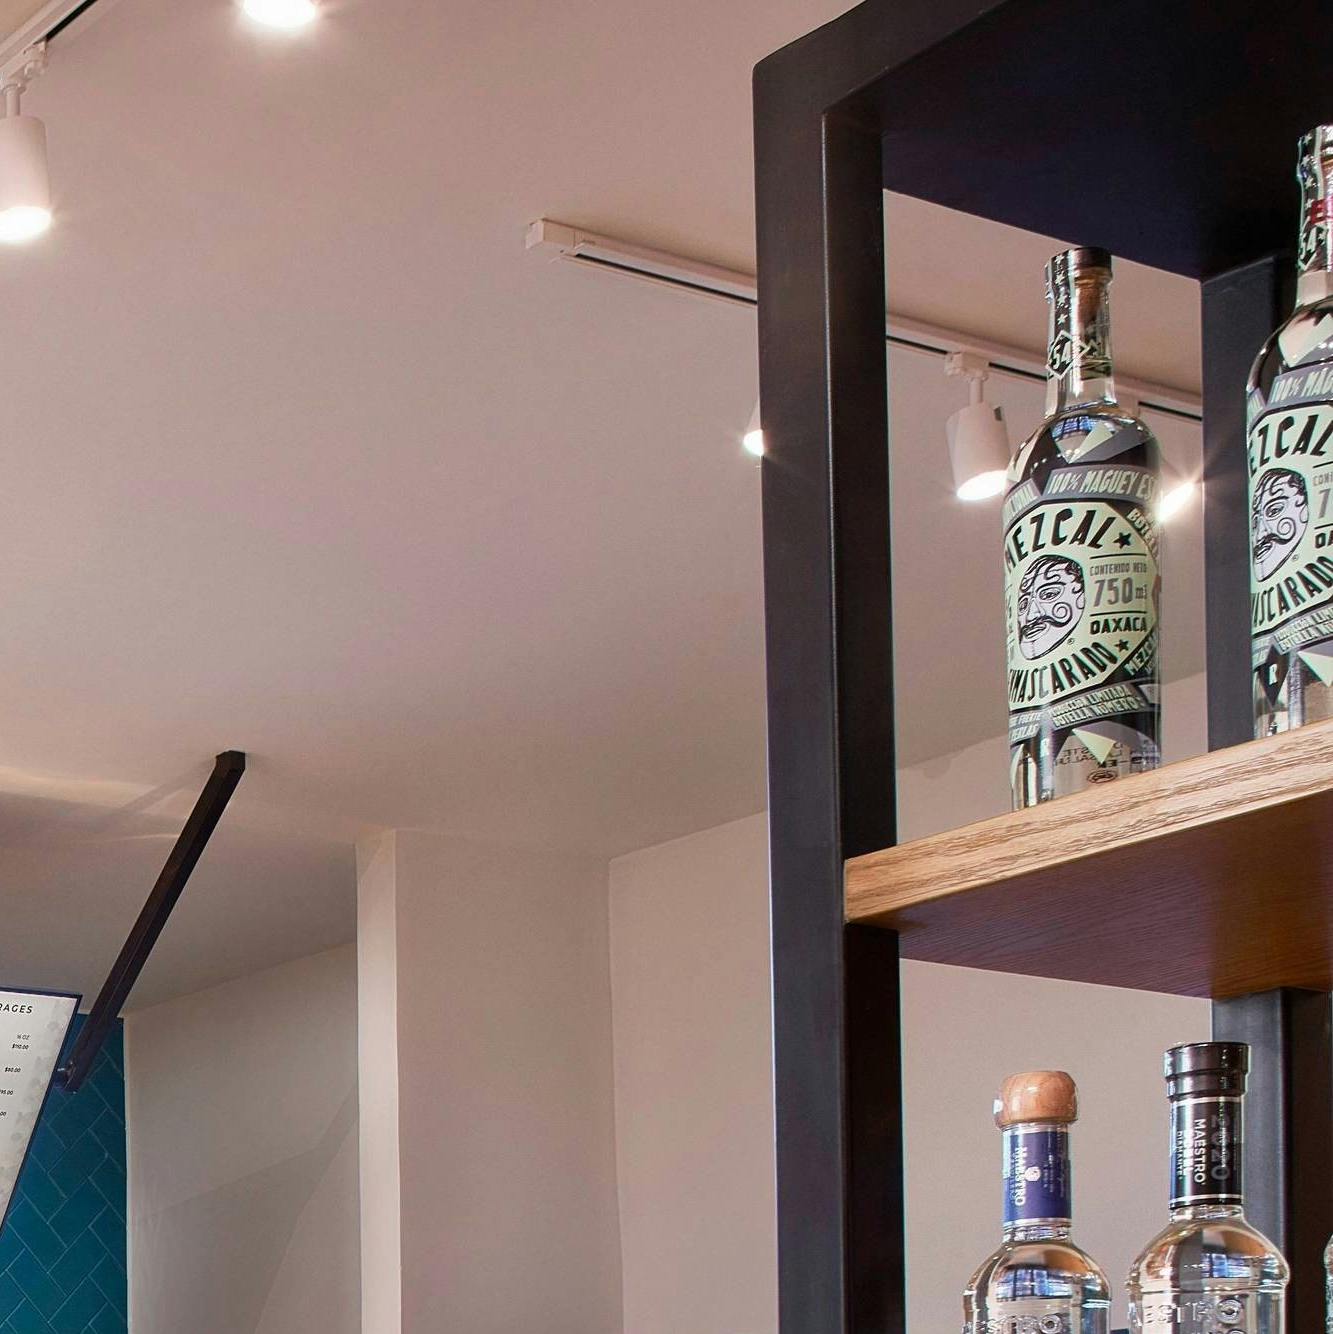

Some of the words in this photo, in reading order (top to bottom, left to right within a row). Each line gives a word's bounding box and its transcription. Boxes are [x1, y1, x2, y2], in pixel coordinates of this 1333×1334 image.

[1048, 471, 1083, 495] 100%
[1079, 469, 1139, 496] MAGUEY
[1005, 508, 1117, 573] MEZCAL
[1090, 564, 1130, 577] CONTENIDO
[1094, 577, 1133, 608] 750
[1090, 617, 1148, 636] OAXACA
